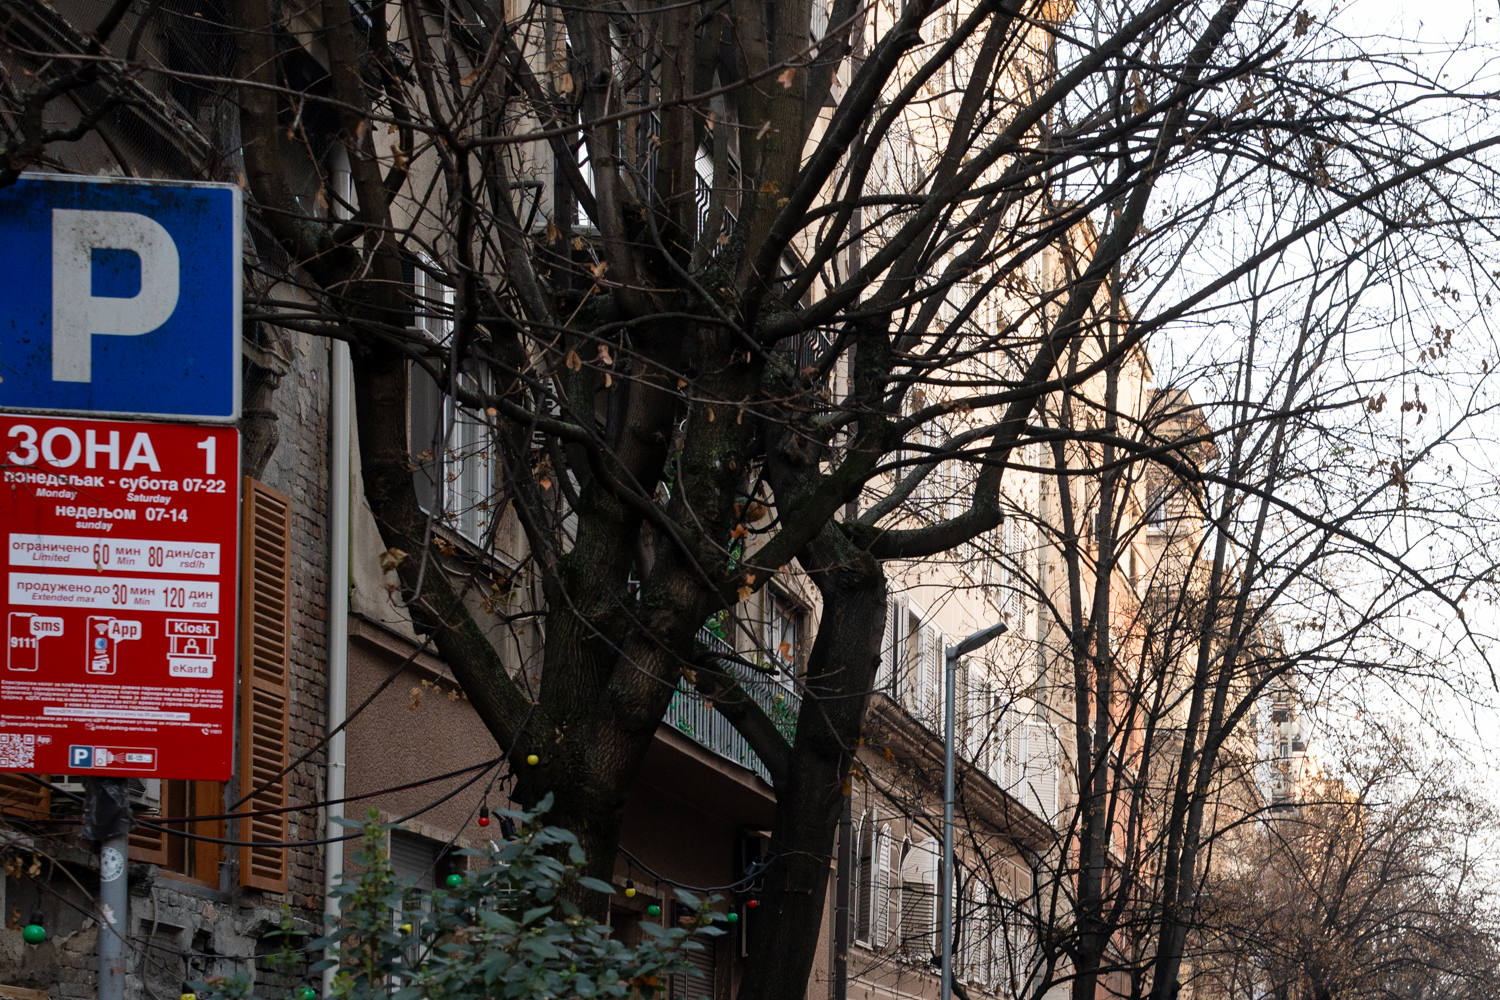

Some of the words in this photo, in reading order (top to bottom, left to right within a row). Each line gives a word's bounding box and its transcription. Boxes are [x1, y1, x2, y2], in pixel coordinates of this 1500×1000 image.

[52, 208, 180, 383] P
[7, 424, 161, 472] ЗОНА
[197, 436, 216, 475] 1
[119, 475, 178, 493] субота
[182, 478, 226, 493] 07-22
[36, 488, 78, 500] Monday
[126, 492, 172, 506] Saturday
[55, 505, 136, 520] недељом
[145, 507, 188, 522] 07-14
[75, 519, 113, 532] sunday
[12, 541, 90, 555] ограничено
[93, 543, 110, 565] 60
[115, 547, 141, 556] мин
[148, 546, 164, 567] 80
[165, 549, 216, 561] дин/сат
[32, 553, 70, 563] Limited
[117, 556, 136, 566] Min
[180, 560, 205, 569] rsd/h
[16, 580, 92, 596] продужено
[94, 584, 111, 596] до
[112, 584, 128, 605] 30
[130, 587, 156, 596] мин
[163, 586, 185, 608] 120
[188, 590, 213, 601] дин
[31, 592, 74, 602] Extended
[76, 595, 96, 603] max
[134, 597, 151, 606] Min
[192, 600, 207, 609] rsd
[33, 619, 61, 632] sms
[112, 622, 138, 639] App
[174, 621, 211, 635] Kiosk
[172, 664, 209, 674] eKarta
[74, 748, 89, 765] P
